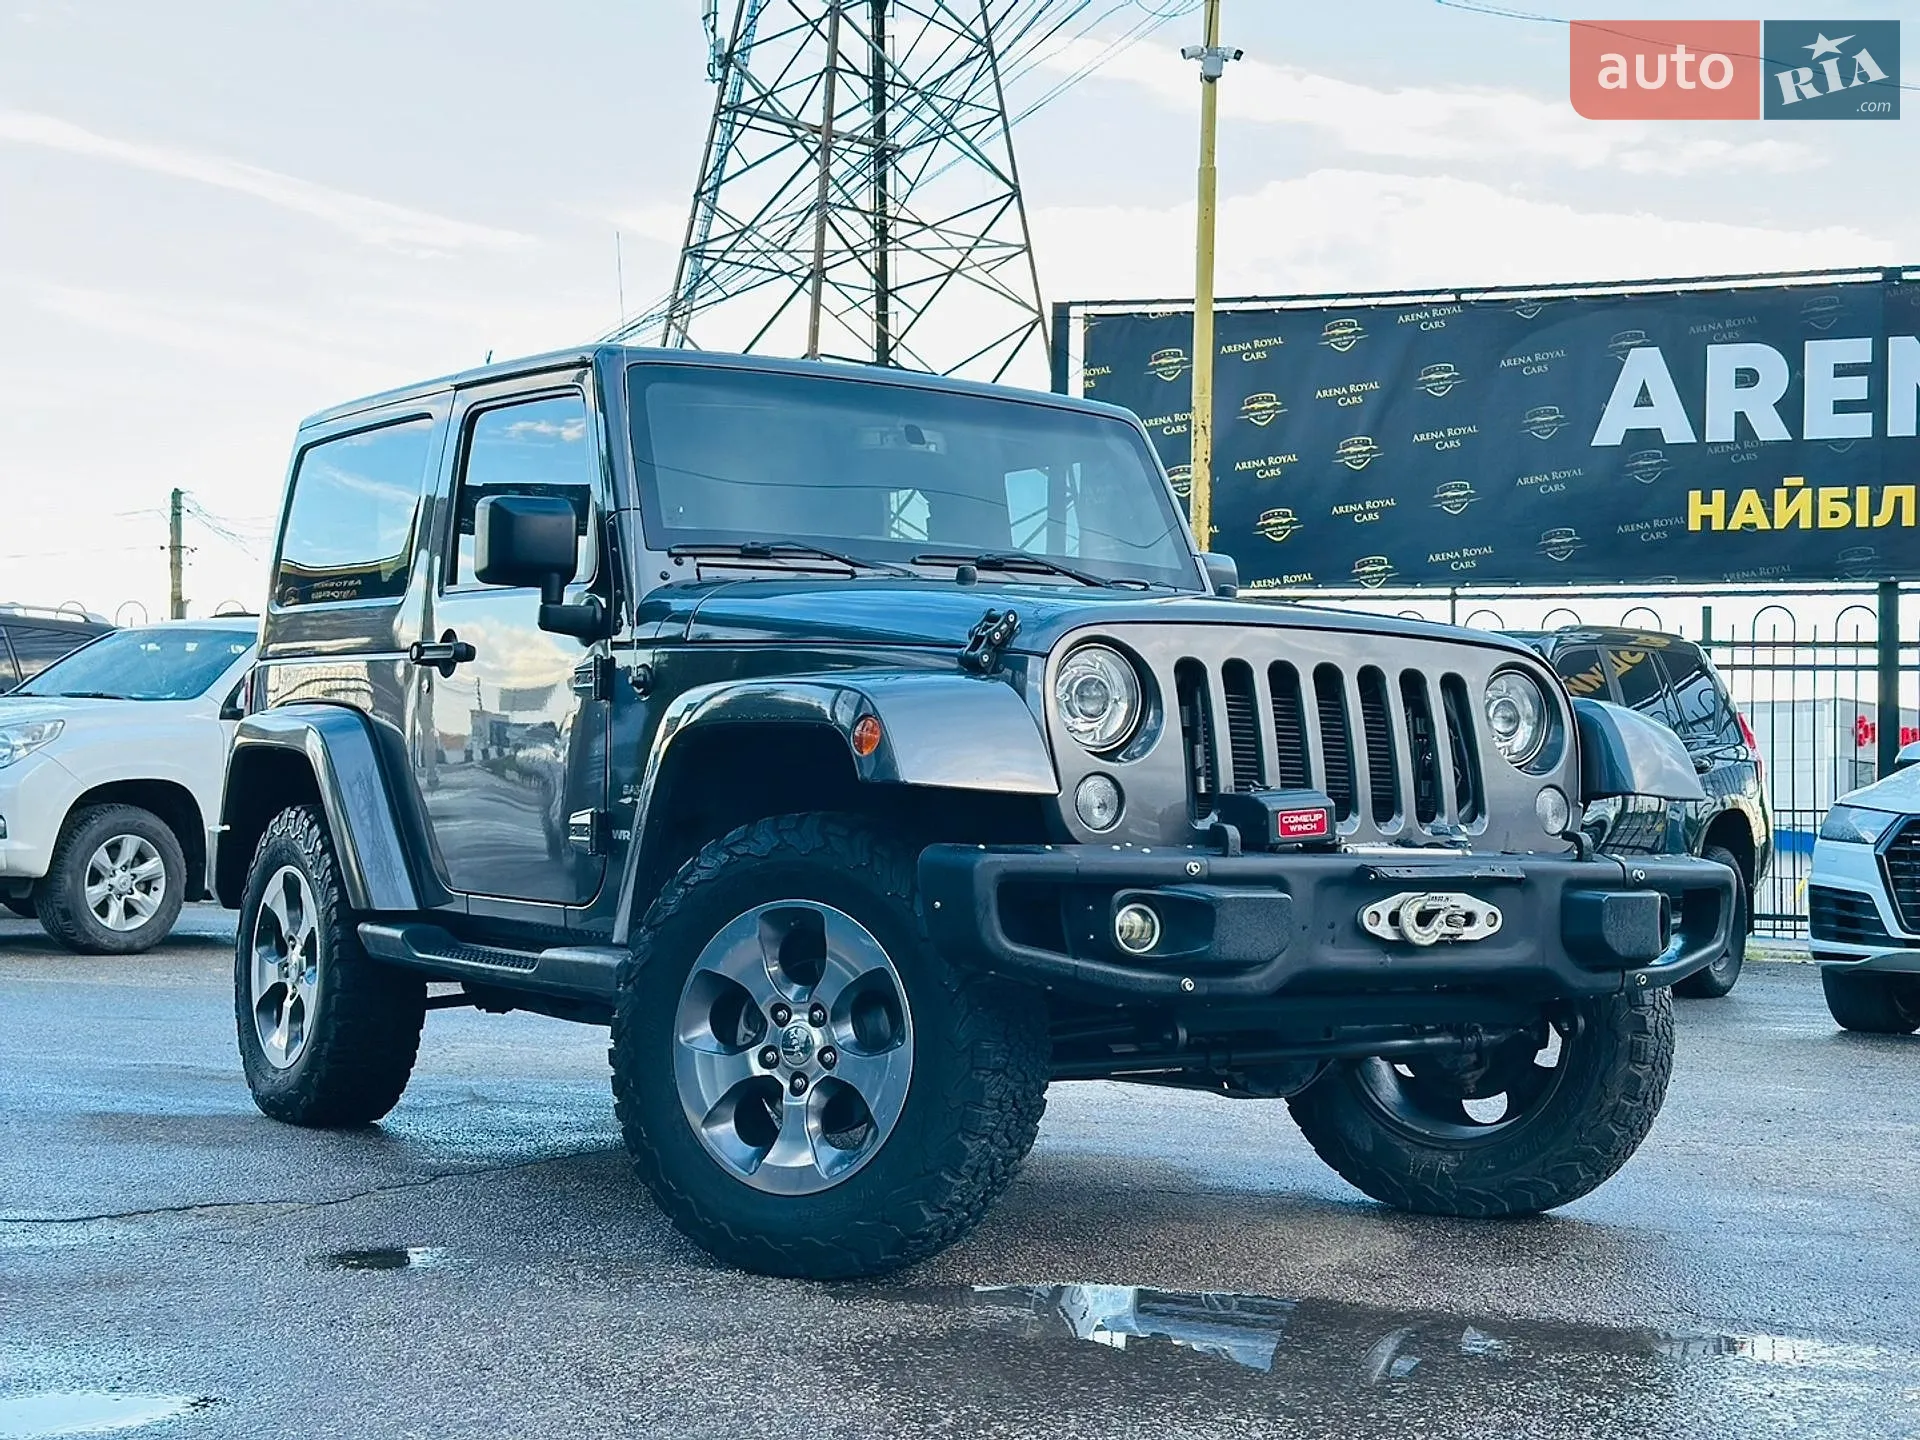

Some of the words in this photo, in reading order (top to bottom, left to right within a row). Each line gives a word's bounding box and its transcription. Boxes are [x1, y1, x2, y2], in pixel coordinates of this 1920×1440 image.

[1397, 312, 1430, 324] ARENA
[1432, 305, 1463, 317] ROYAL
[1420, 319, 1446, 331] CARS
[1220, 343, 1252, 355] ARENA
[1254, 336, 1284, 348] ROYAL
[1242, 351, 1267, 362] CARS
[1499, 356, 1532, 368] ARENA
[1535, 349, 1566, 362] ROYAL
[1522, 364, 1549, 376] CARS
[1315, 387, 1347, 399] ARENA
[1350, 381, 1381, 393] ROYAL
[1337, 395, 1363, 407] CARS
[1412, 431, 1444, 443] ARENA
[1447, 424, 1479, 437] ROYAL
[1434, 439, 1461, 451] CARS
[1234, 460, 1266, 471] ARENA
[1268, 454, 1298, 465] ROYAL
[1256, 468, 1281, 479] CARS
[1516, 474, 1550, 486] ARENA
[1552, 468, 1584, 481] ROYAL
[1539, 483, 1566, 495] CARS
[1331, 503, 1364, 515] ARENA
[1366, 497, 1396, 510] ROYAL
[1688, 476, 1916, 531] НАЙБІЛ
[1354, 512, 1380, 523] CARS
[1616, 521, 1650, 534] ARENA
[1653, 516, 1686, 528] ROYAL
[1641, 530, 1668, 542] CARS
[1427, 552, 1460, 563] ARENA
[1463, 545, 1495, 558] ROYAL
[1450, 560, 1476, 571] CARS
[1250, 577, 1281, 589] ARENA
[1282, 572, 1314, 584] ROYAL
[1282, 813, 1323, 824] COMEUP
[1289, 823, 1318, 832] WINCH
